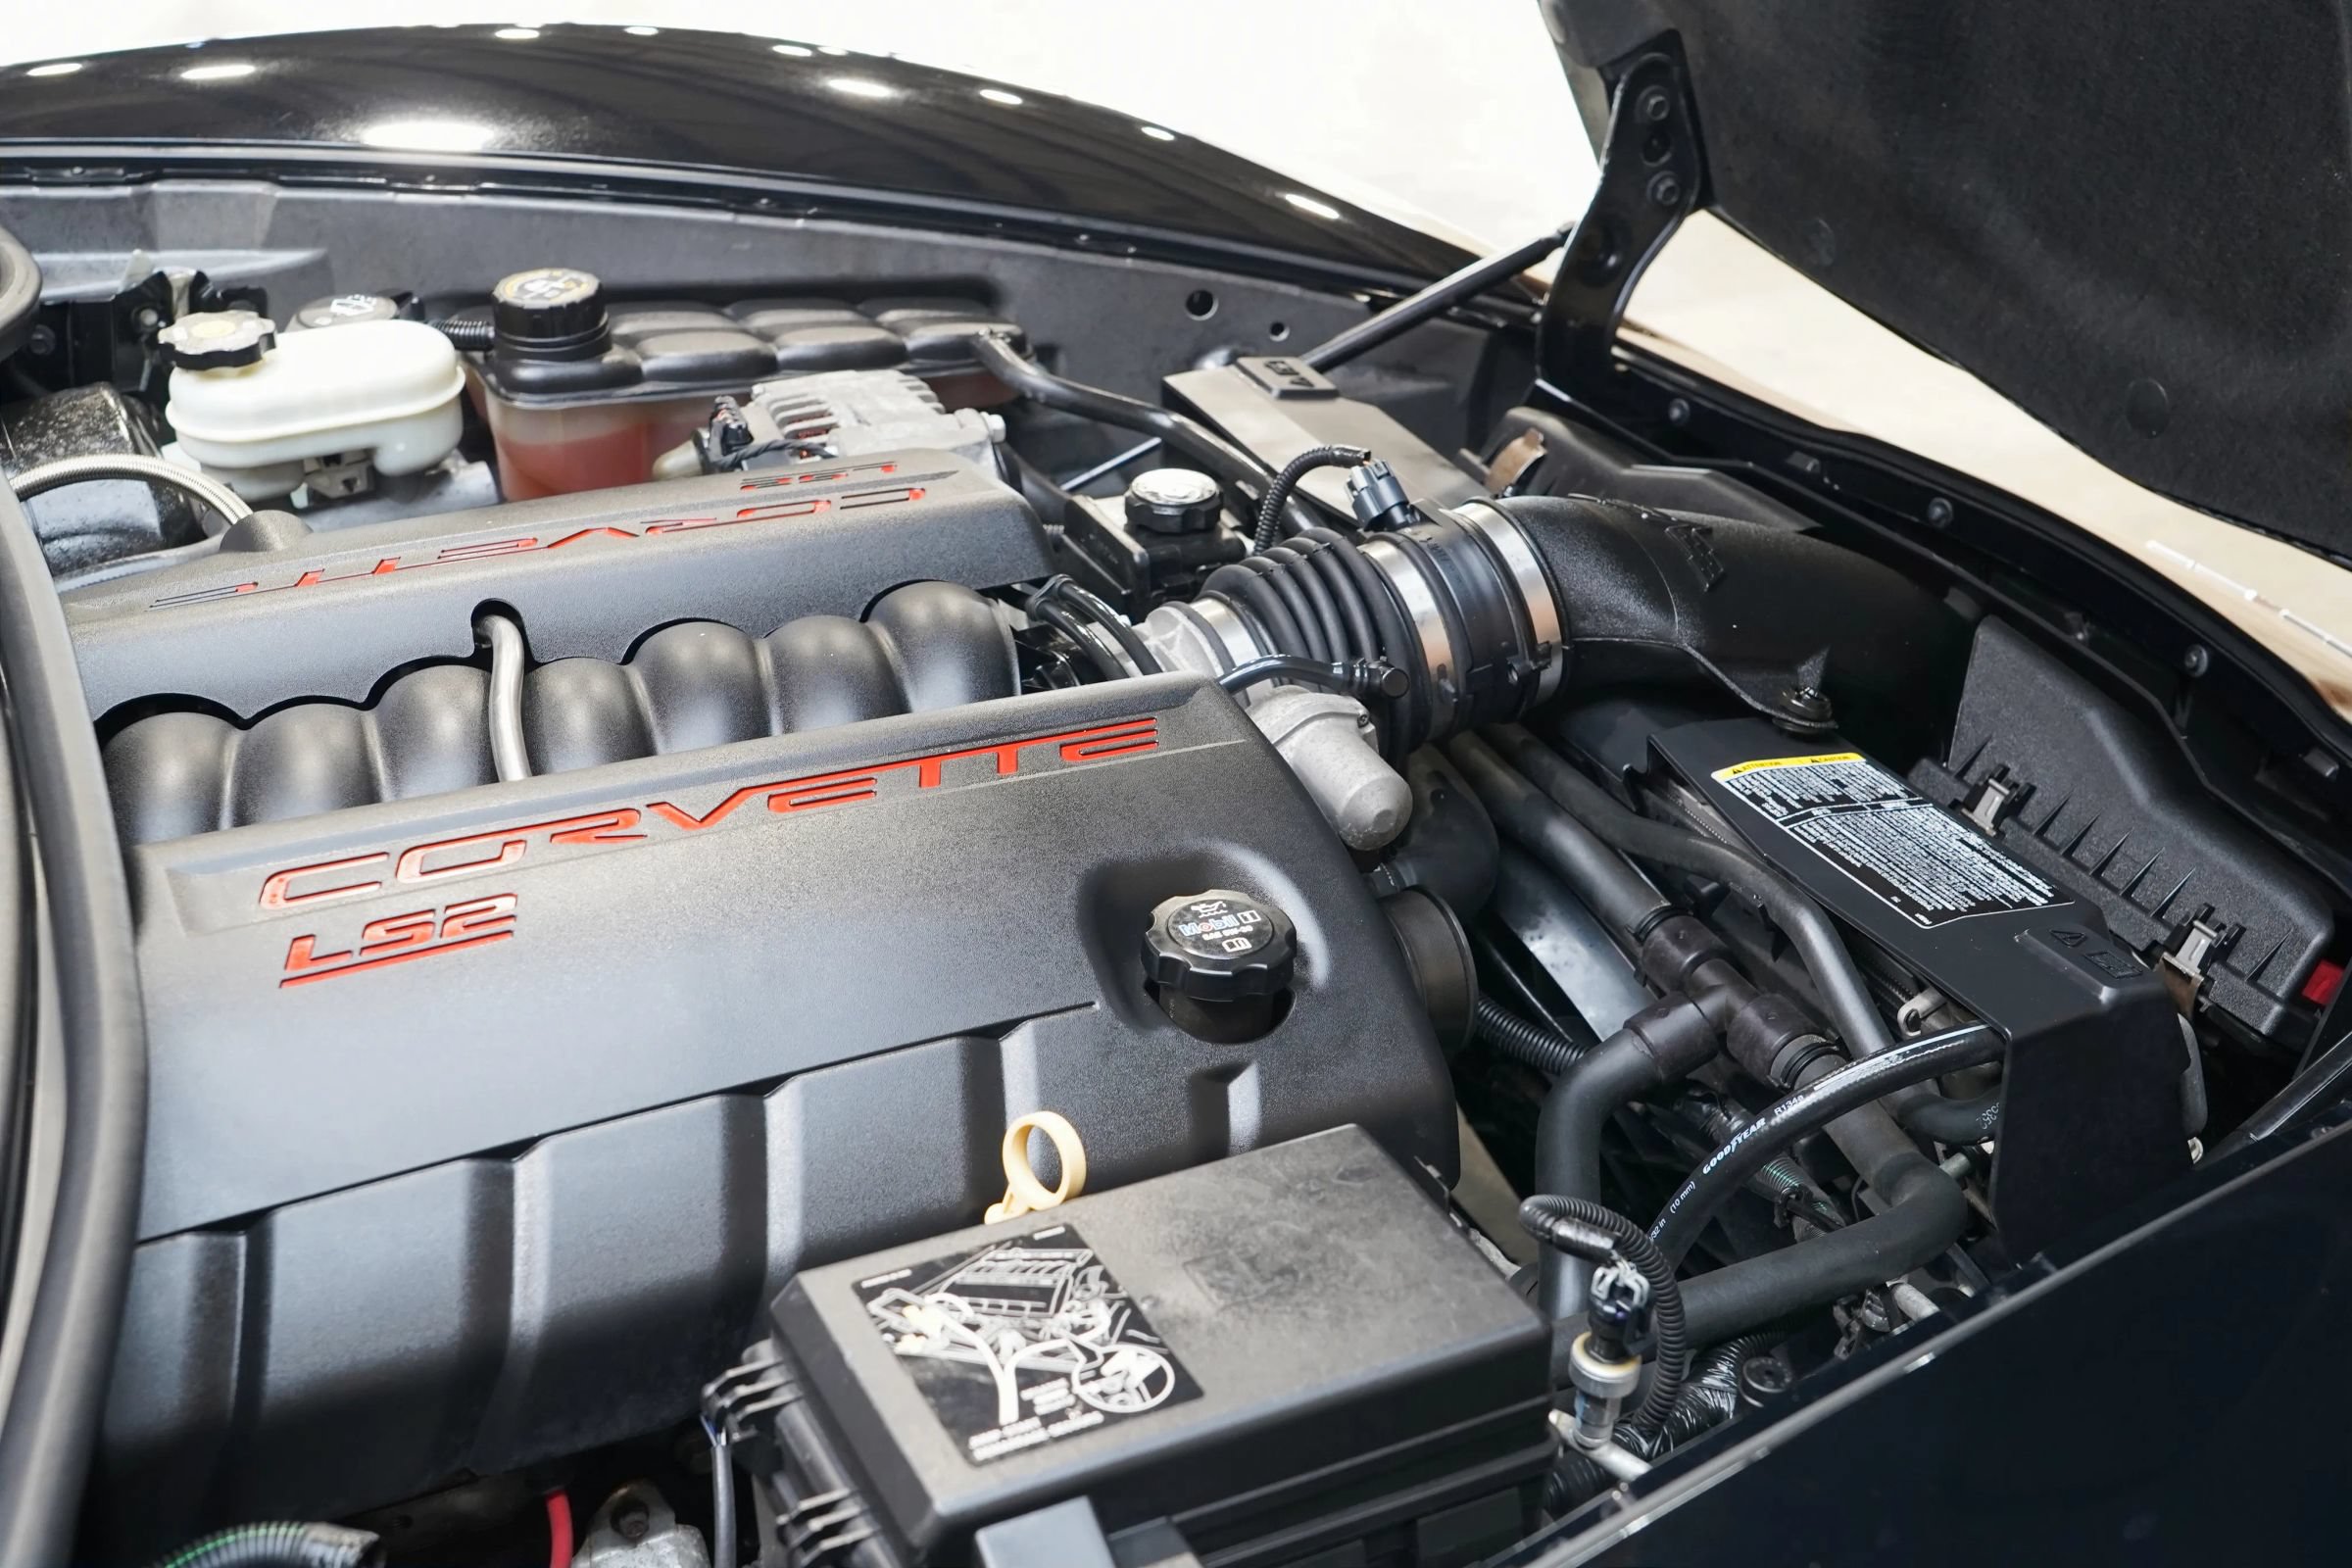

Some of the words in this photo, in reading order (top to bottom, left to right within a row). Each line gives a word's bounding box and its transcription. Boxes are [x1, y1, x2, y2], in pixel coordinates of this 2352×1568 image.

[259, 716, 1158, 910] CORVETTE
[284, 893, 518, 971] LS2
[1178, 914, 1240, 937] Mobil
[1669, 1198, 1681, 1214] (10
[1680, 1181, 1696, 1200] mm)
[1702, 1118, 1766, 1175] GOODYEAR
